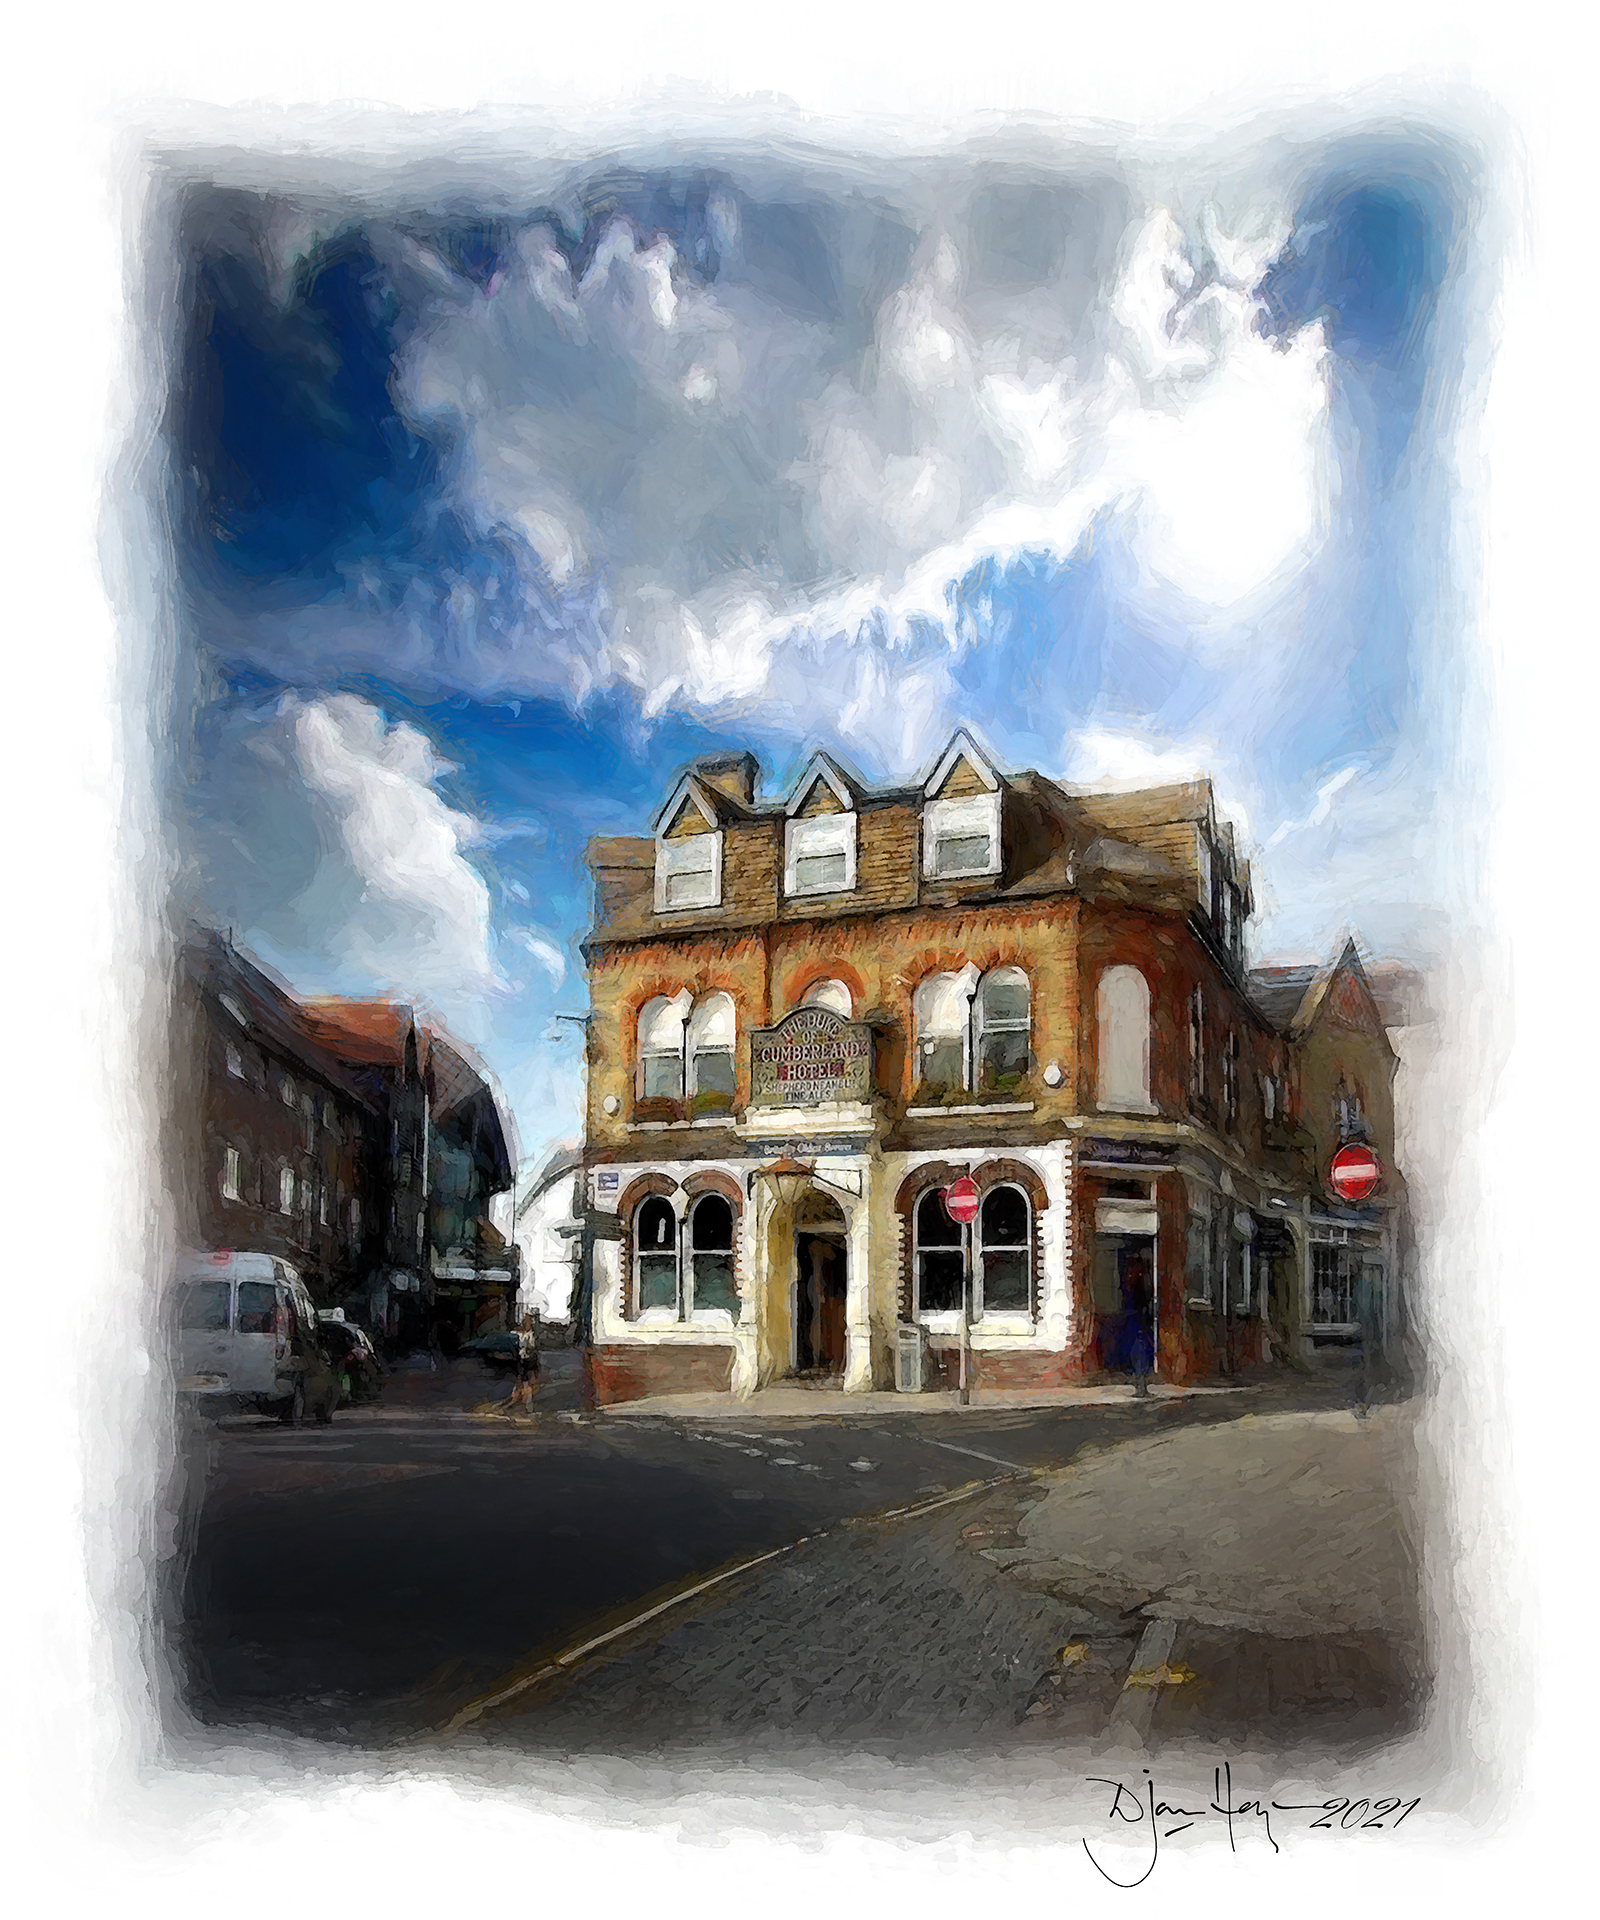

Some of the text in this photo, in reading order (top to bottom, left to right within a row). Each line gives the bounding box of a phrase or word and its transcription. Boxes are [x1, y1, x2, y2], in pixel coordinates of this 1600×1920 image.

[779, 1012, 843, 1040] THE DUKE
[801, 1030, 818, 1044] OF
[761, 1040, 860, 1062] CUMBERLAND
[786, 1062, 836, 1080] HOTEL
